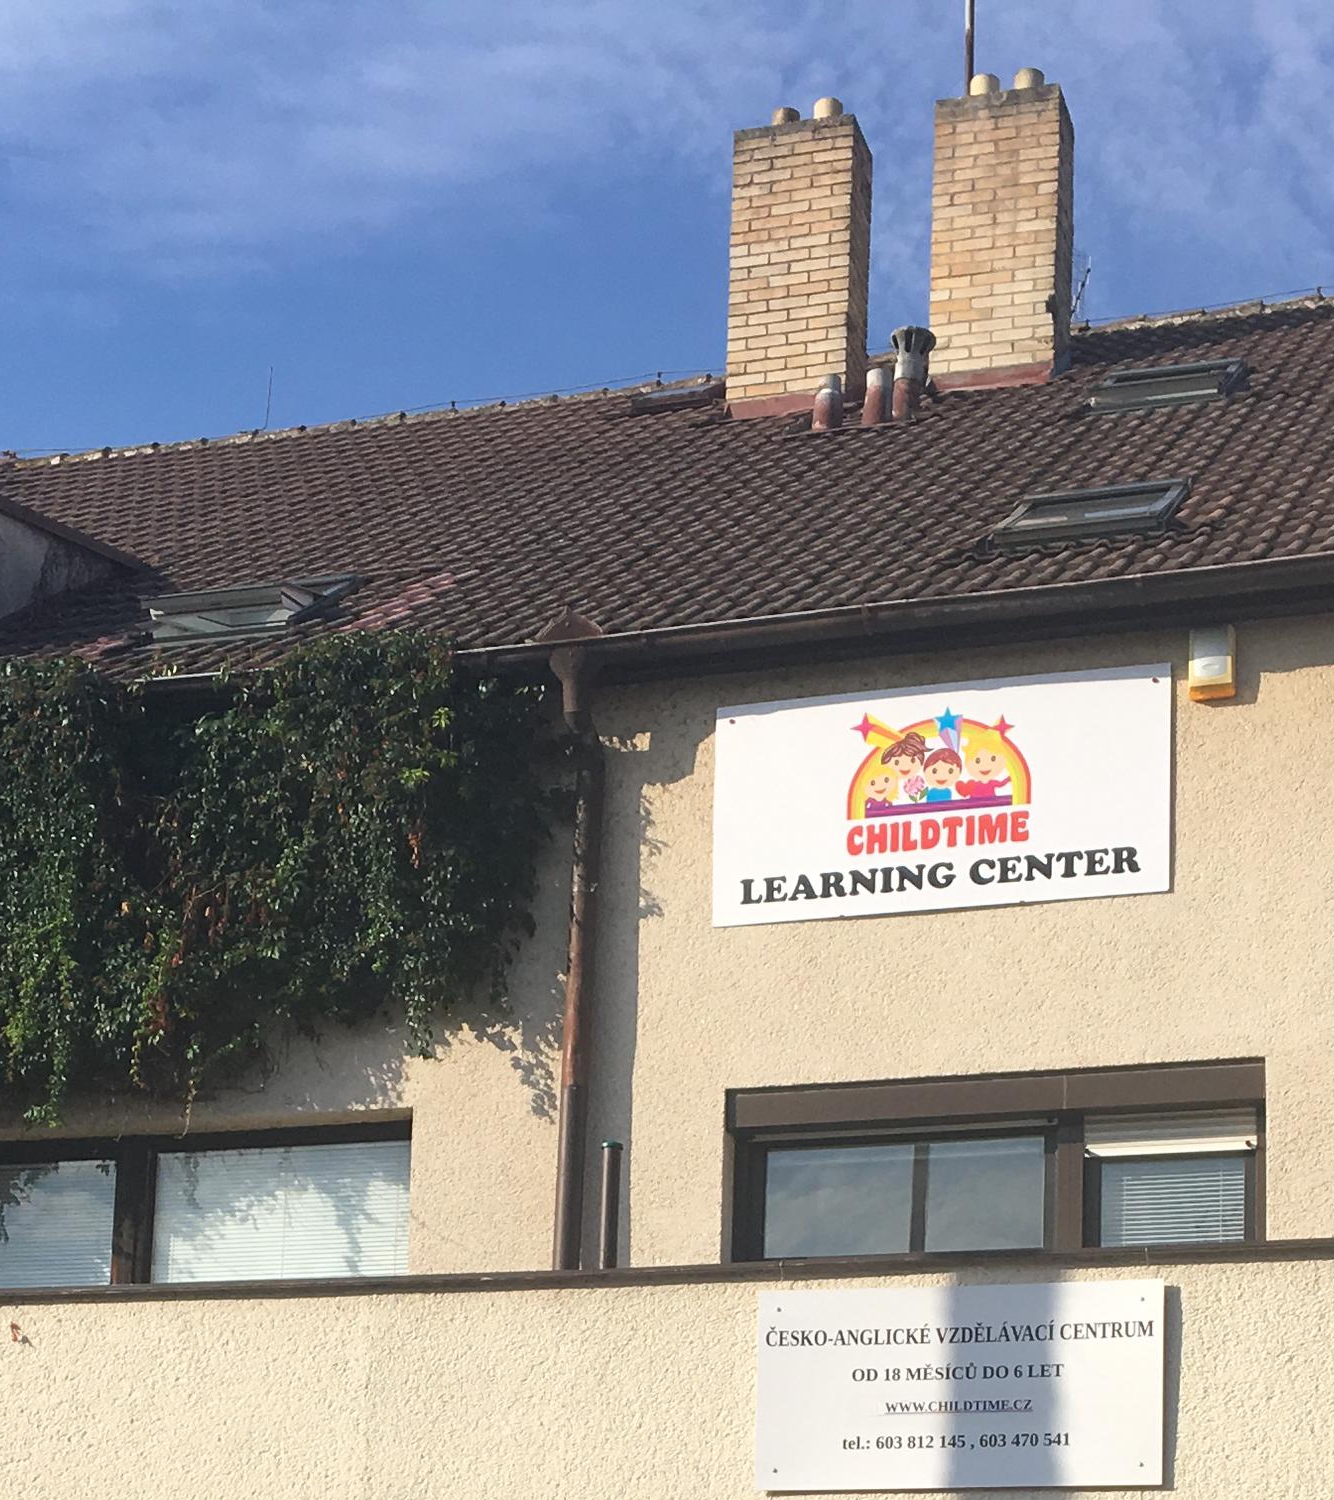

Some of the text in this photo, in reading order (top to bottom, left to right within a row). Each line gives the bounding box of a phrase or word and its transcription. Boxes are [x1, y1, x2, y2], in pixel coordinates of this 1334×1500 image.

[846, 810, 1030, 857] CHILDTIME
[740, 846, 1141, 906] LEARNING CENTER
[765, 1319, 1155, 1347] ČESKO-ANGLICKÉ VZDĚLÁVACÍ CENTRUM
[851, 1361, 1065, 1383] OD 18 MĚSÍCŮ DO 6 LET
[884, 1398, 1034, 1414] WWW.CHILDTIME.CZ
[842, 1436, 871, 1450] tel.:
[875, 1436, 903, 1450] 603
[907, 1435, 934, 1449] 812
[939, 1434, 966, 1449] 145
[979, 1434, 1007, 1448] 603
[1010, 1433, 1039, 1448] 470
[1042, 1432, 1070, 1447] 541
